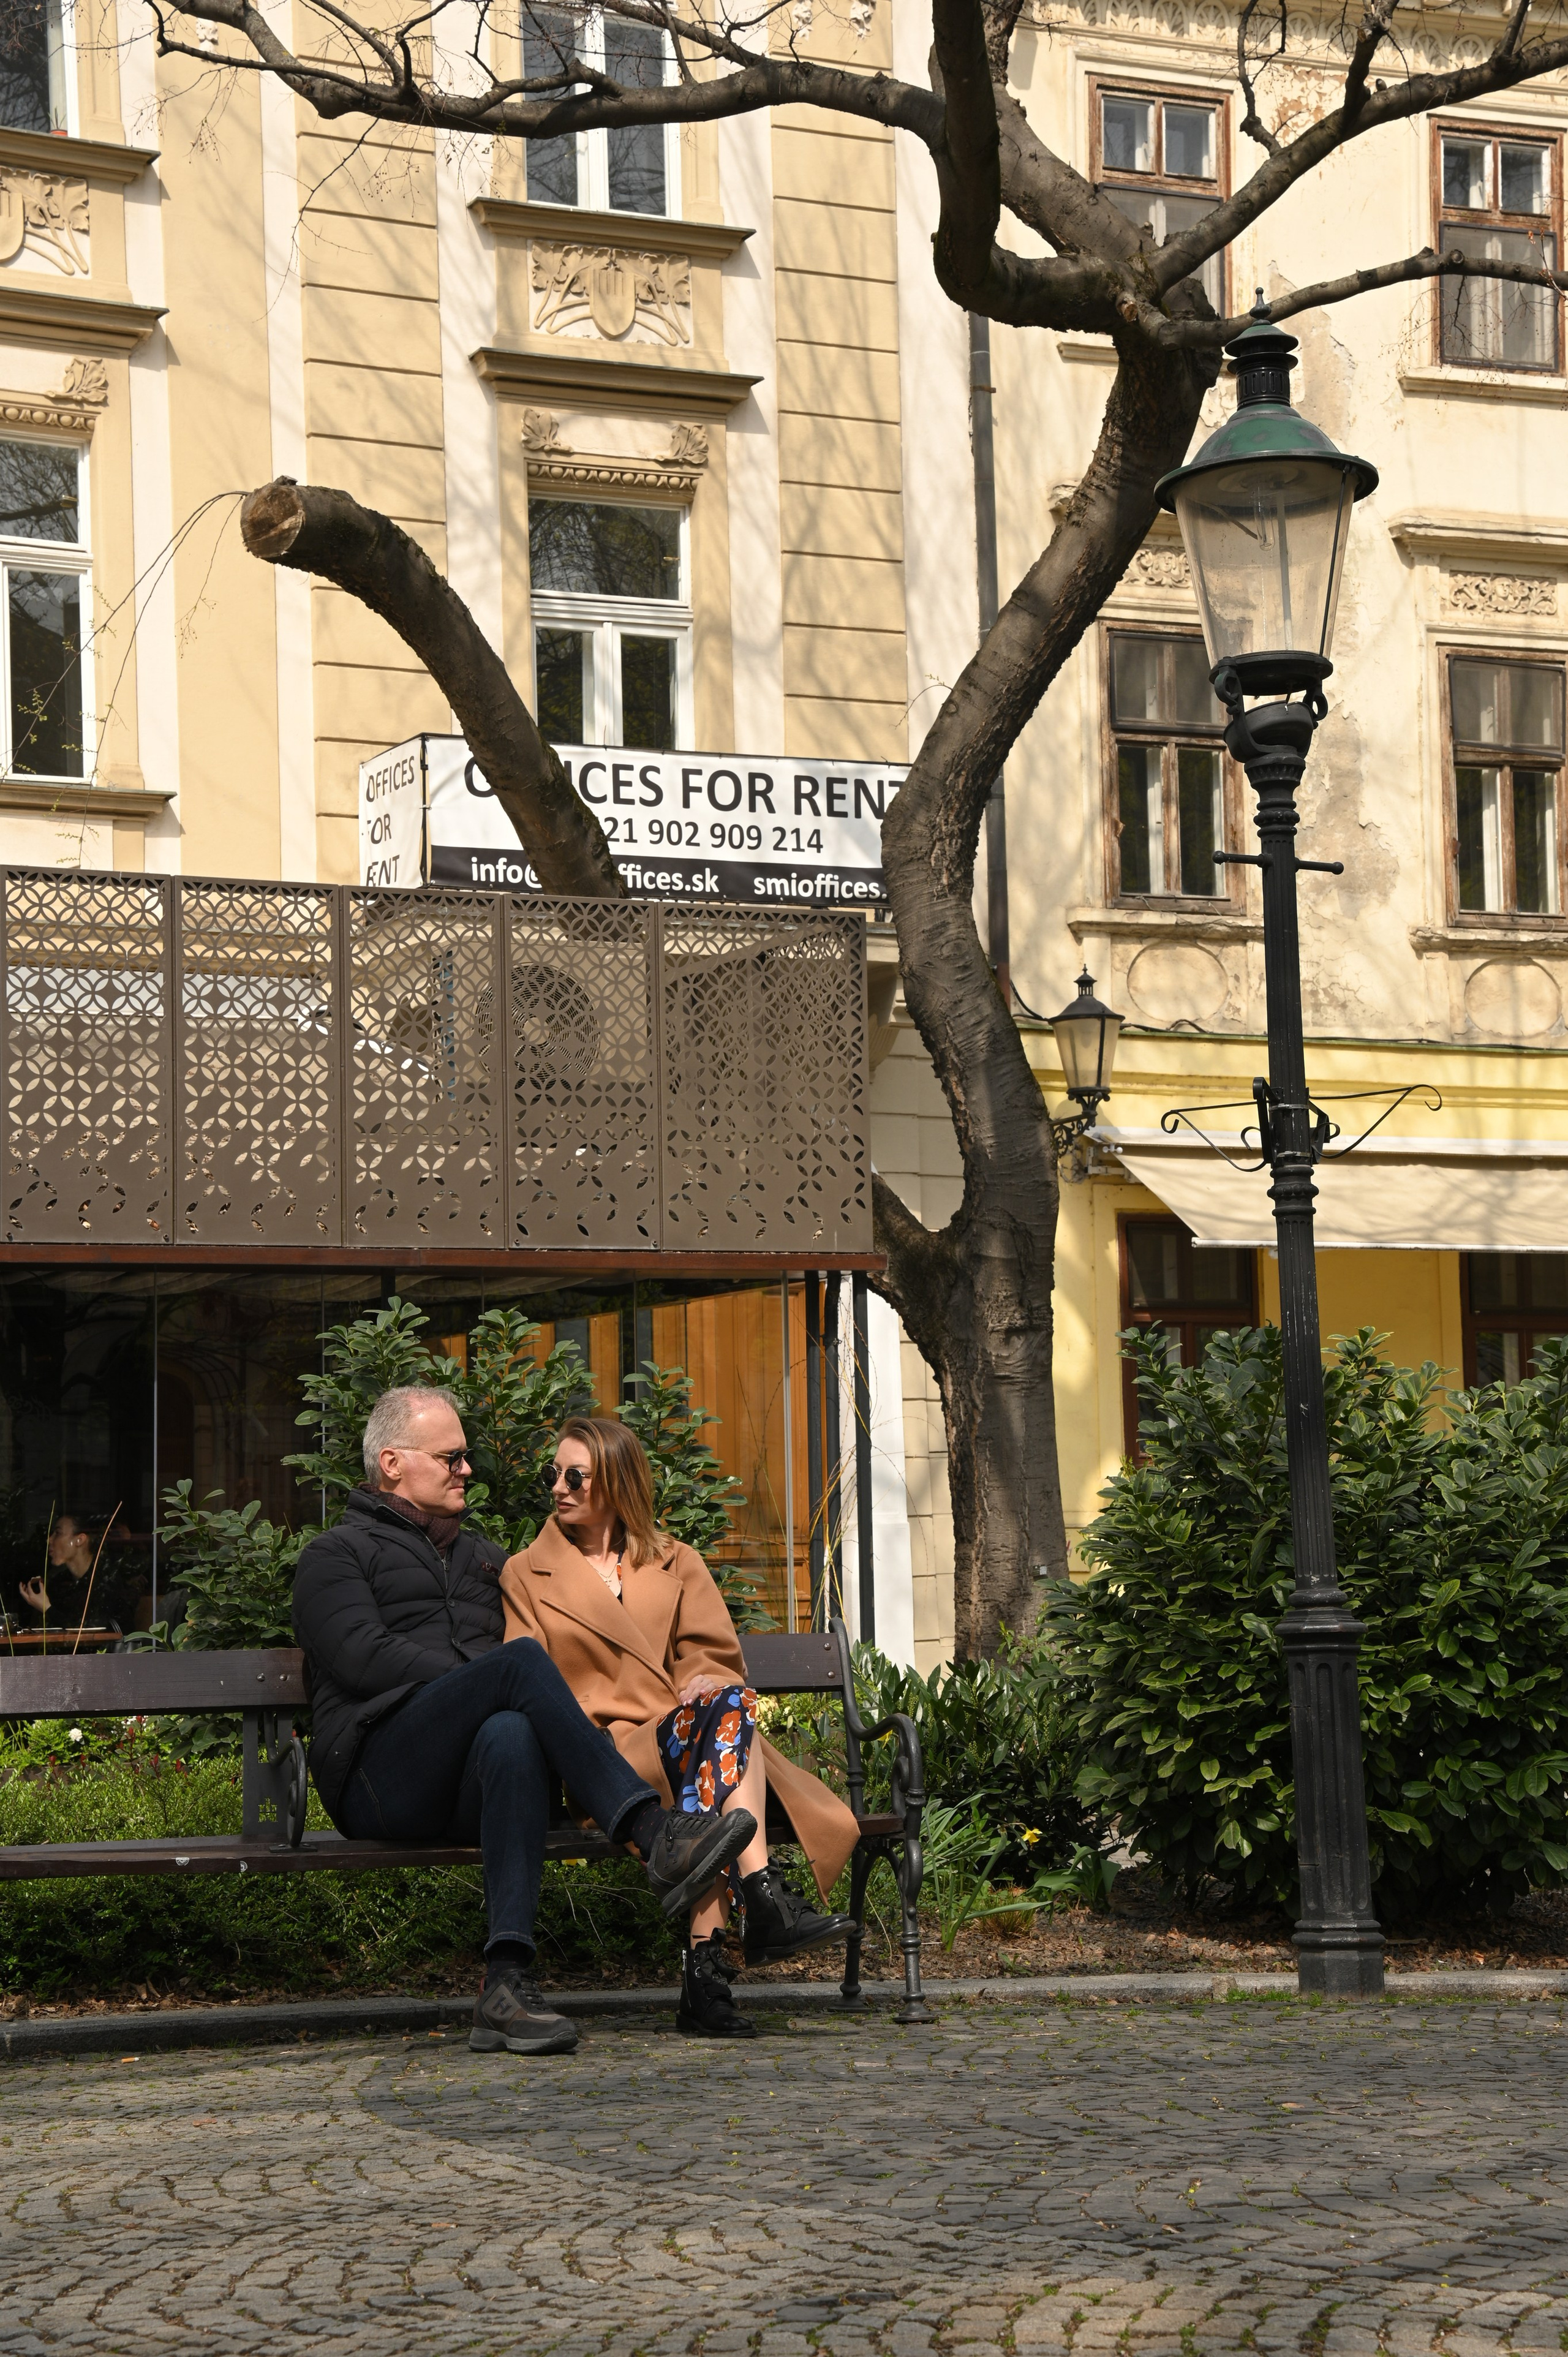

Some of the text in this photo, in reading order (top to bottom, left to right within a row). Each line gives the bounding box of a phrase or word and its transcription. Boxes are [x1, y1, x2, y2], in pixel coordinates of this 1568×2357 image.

[366, 755, 415, 802] OFFICES
[464, 756, 663, 807] OICES
[682, 768, 775, 813] FOR
[367, 813, 391, 844] OR
[648, 819, 701, 848] 902
[710, 823, 762, 850] 909
[772, 826, 824, 853] 214
[753, 872, 888, 899] smioffices.
